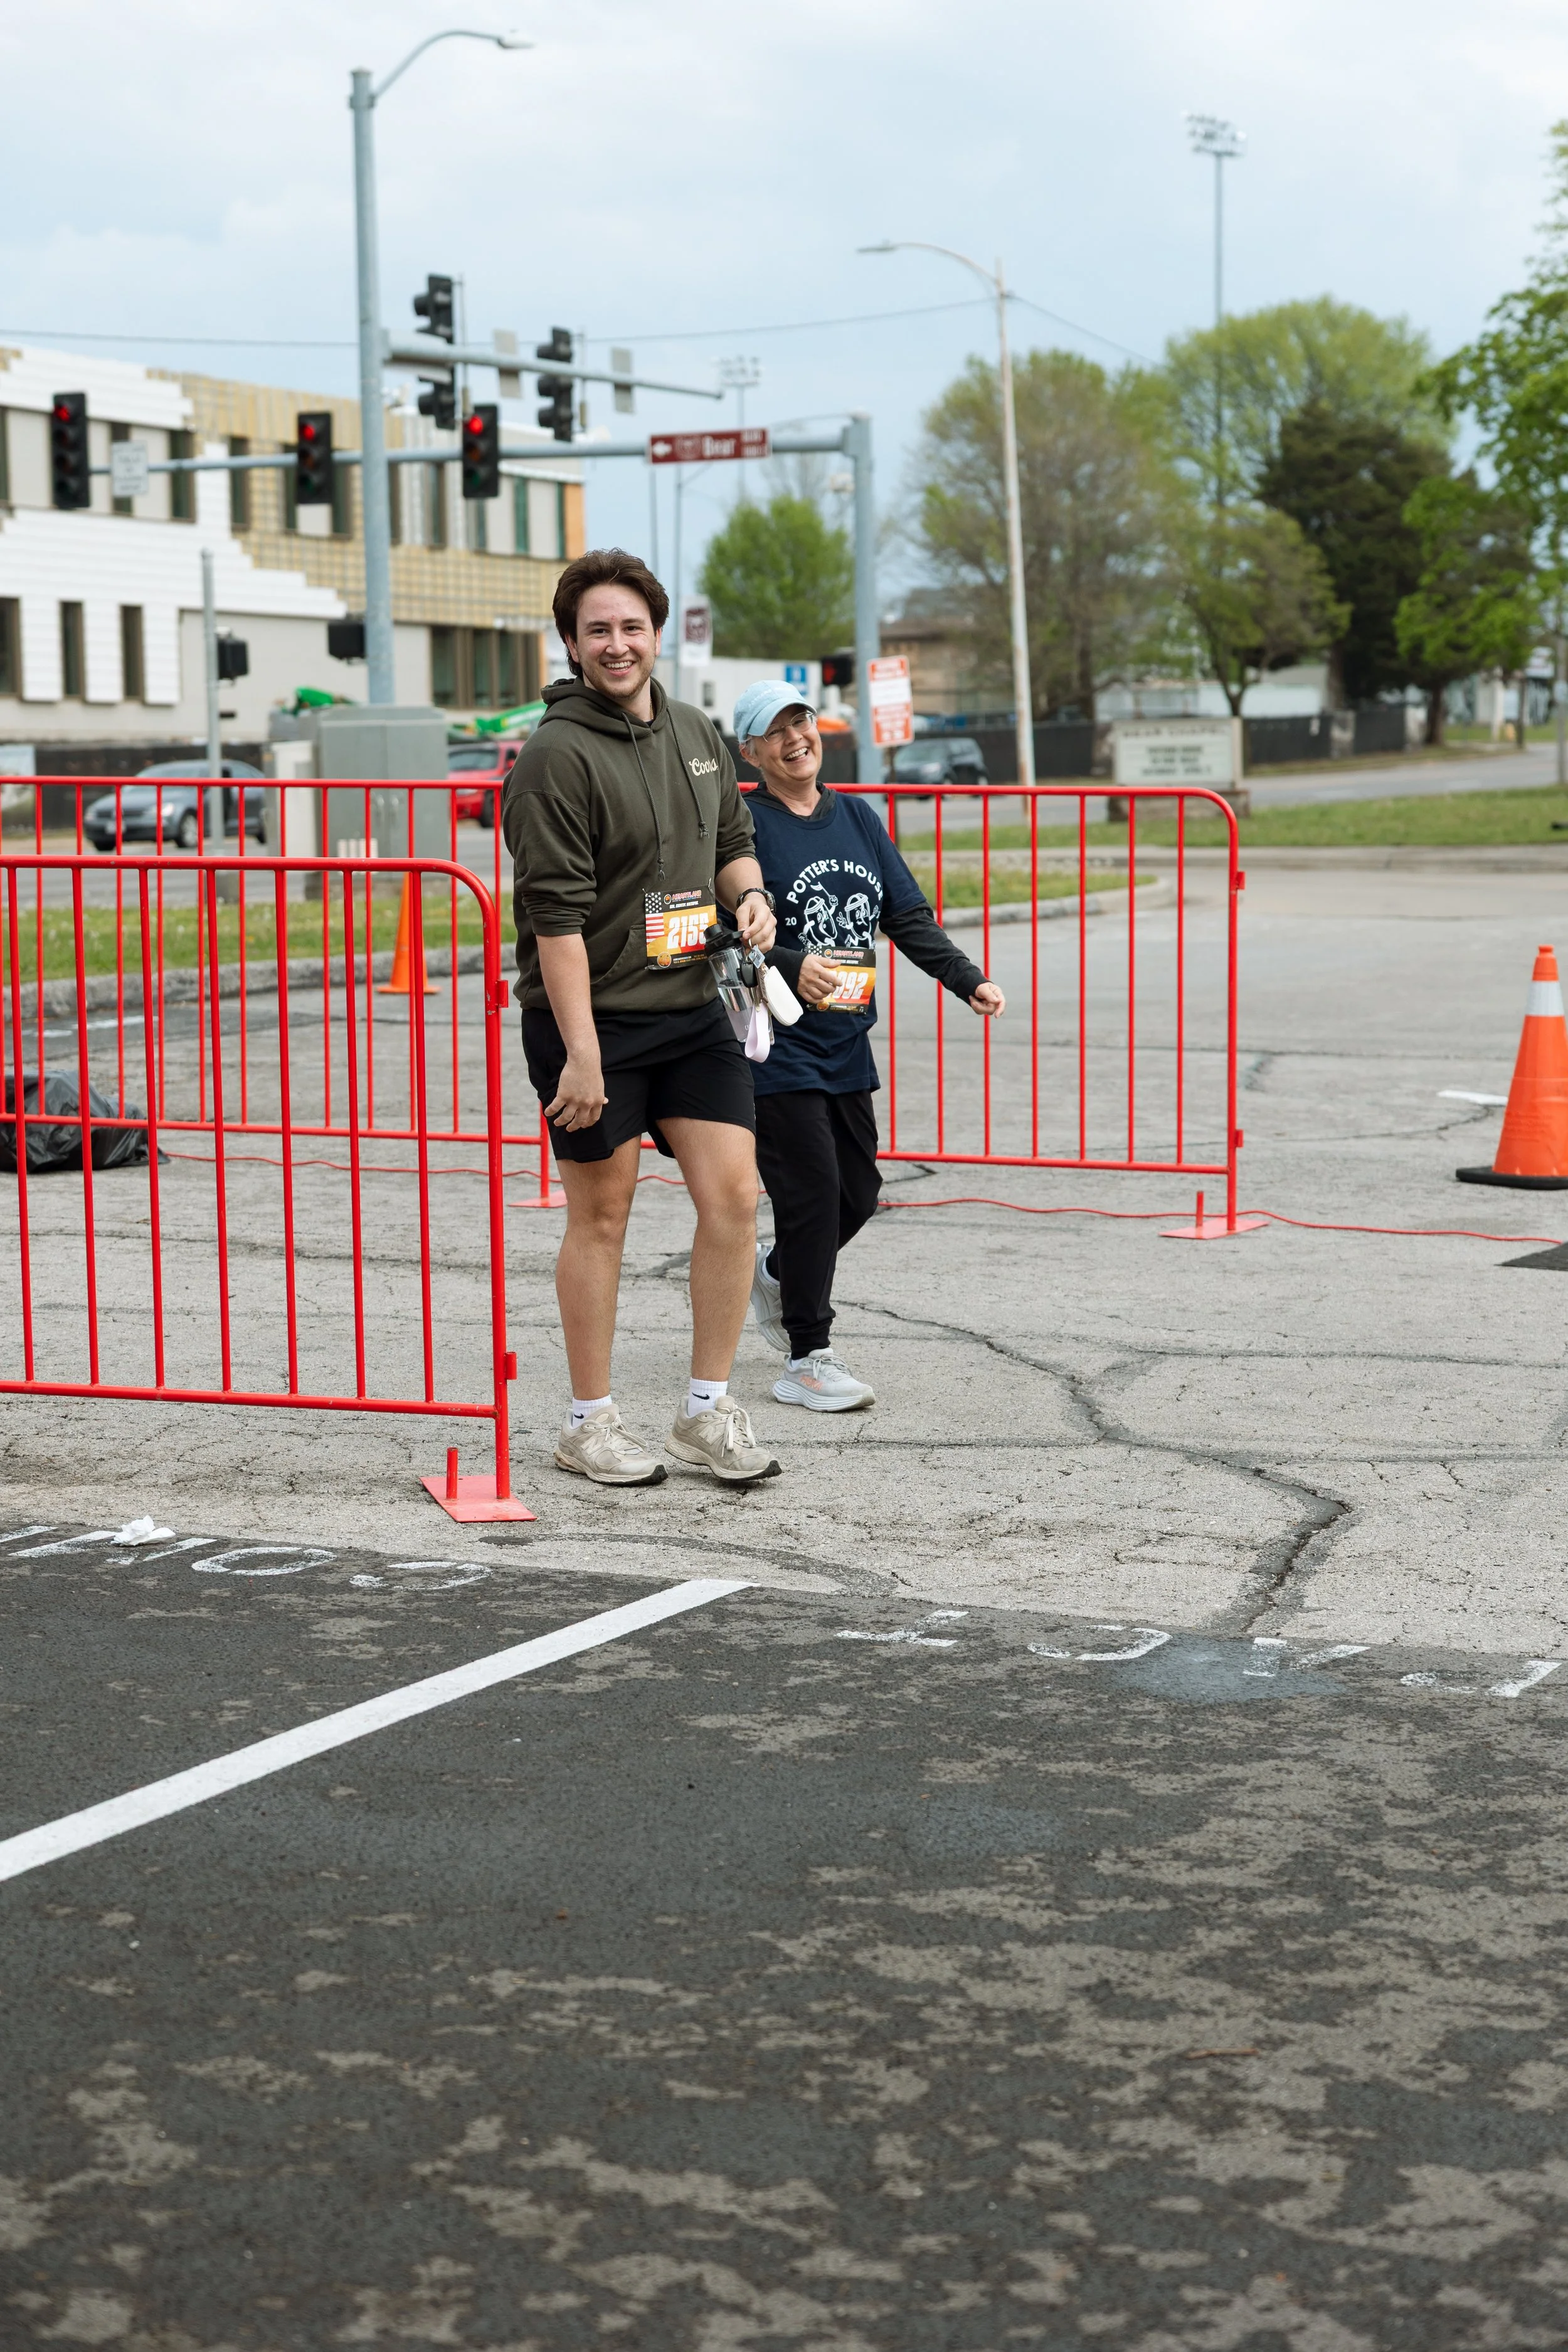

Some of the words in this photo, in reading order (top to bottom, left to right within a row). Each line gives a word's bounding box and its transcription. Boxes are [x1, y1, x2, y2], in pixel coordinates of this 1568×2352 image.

[689, 758, 718, 776] Coors
[786, 859, 840, 904] POTTER'S
[844, 860, 883, 901] HOUSE
[667, 912, 709, 950] 2155
[785, 916, 797, 926] 20
[824, 970, 869, 999] 092
[0, 1525, 493, 1591] COM
